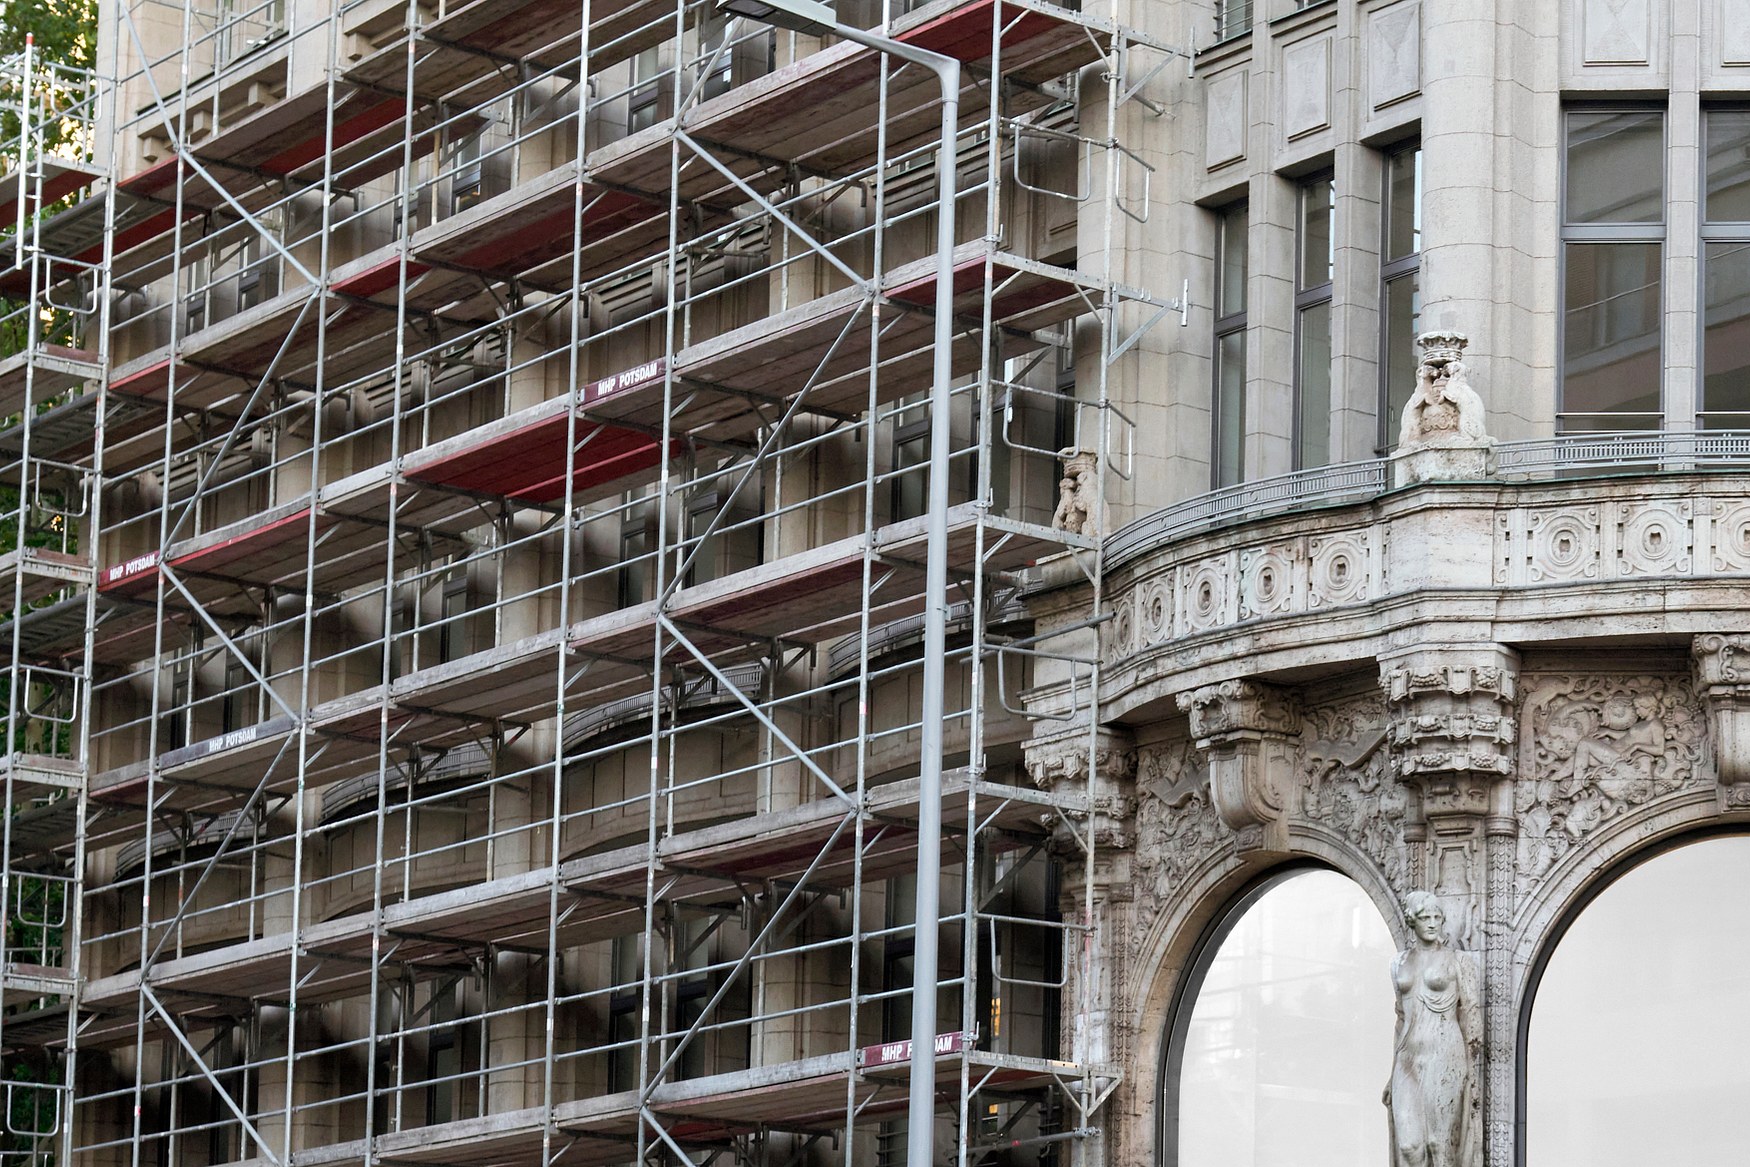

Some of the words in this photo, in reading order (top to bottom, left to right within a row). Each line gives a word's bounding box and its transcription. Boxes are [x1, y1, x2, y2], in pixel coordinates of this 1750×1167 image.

[597, 377, 616, 396] MHP
[619, 362, 658, 388] POTSDAM
[109, 565, 124, 582] MHP
[126, 554, 155, 576] POTSDAM
[209, 737, 223, 752] MHP
[225, 727, 257, 747] POTSDAM
[881, 1044, 903, 1061] MHP
